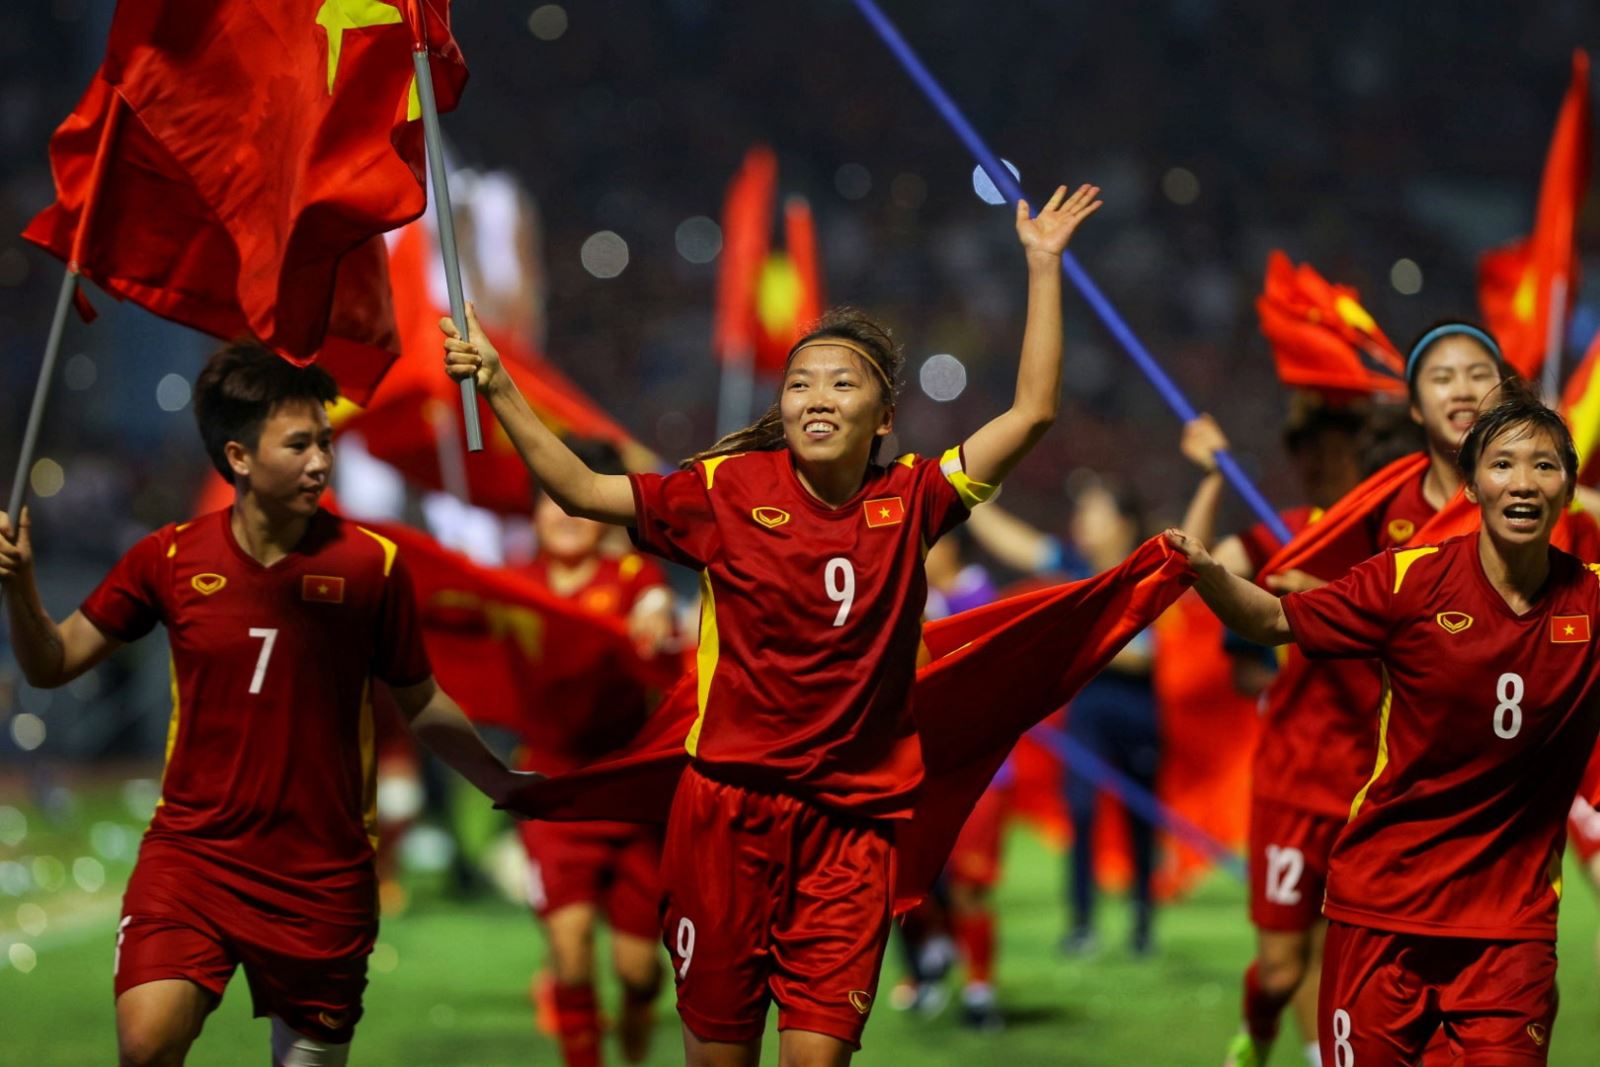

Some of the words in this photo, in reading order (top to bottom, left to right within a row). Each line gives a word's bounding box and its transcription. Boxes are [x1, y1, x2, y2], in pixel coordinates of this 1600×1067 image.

[824, 557, 855, 627] 9
[248, 627, 278, 694] 7
[1493, 672, 1524, 739] 8
[1265, 844, 1304, 905] 12
[677, 917, 695, 980] 9
[1333, 1008, 1354, 1067] 8
